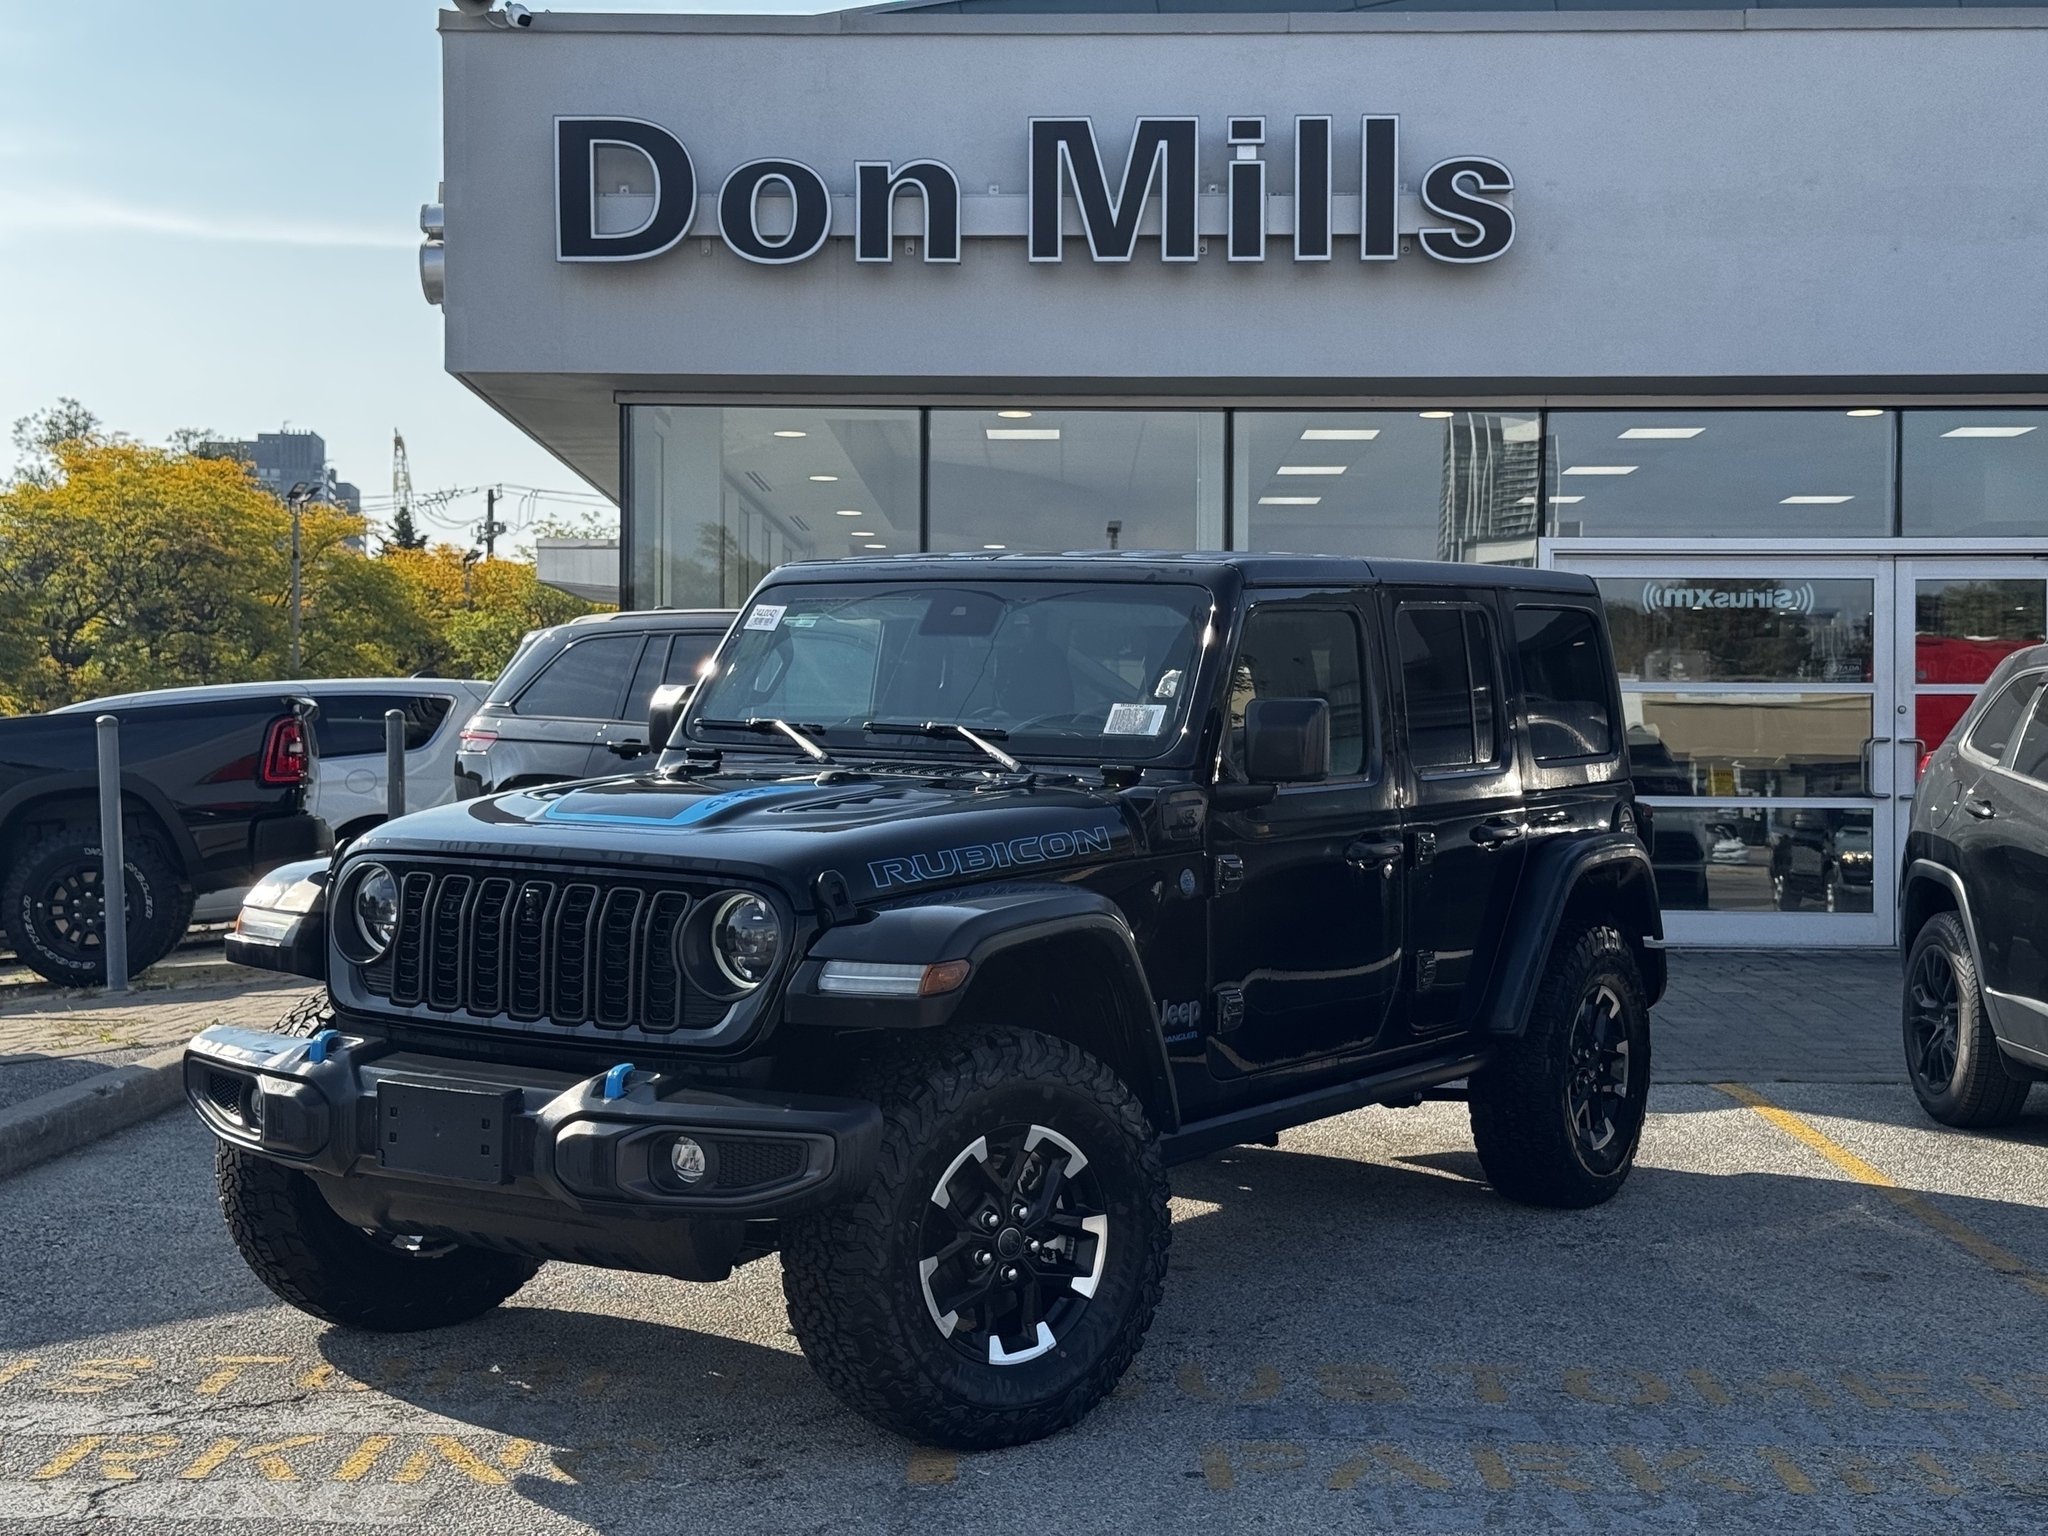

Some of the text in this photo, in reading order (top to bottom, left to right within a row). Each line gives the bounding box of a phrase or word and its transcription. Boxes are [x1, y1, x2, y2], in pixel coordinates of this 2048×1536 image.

[552, 114, 1517, 265] Don Mills
[867, 826, 1112, 888] RUBICON
[1160, 999, 1201, 1027] Jeep
